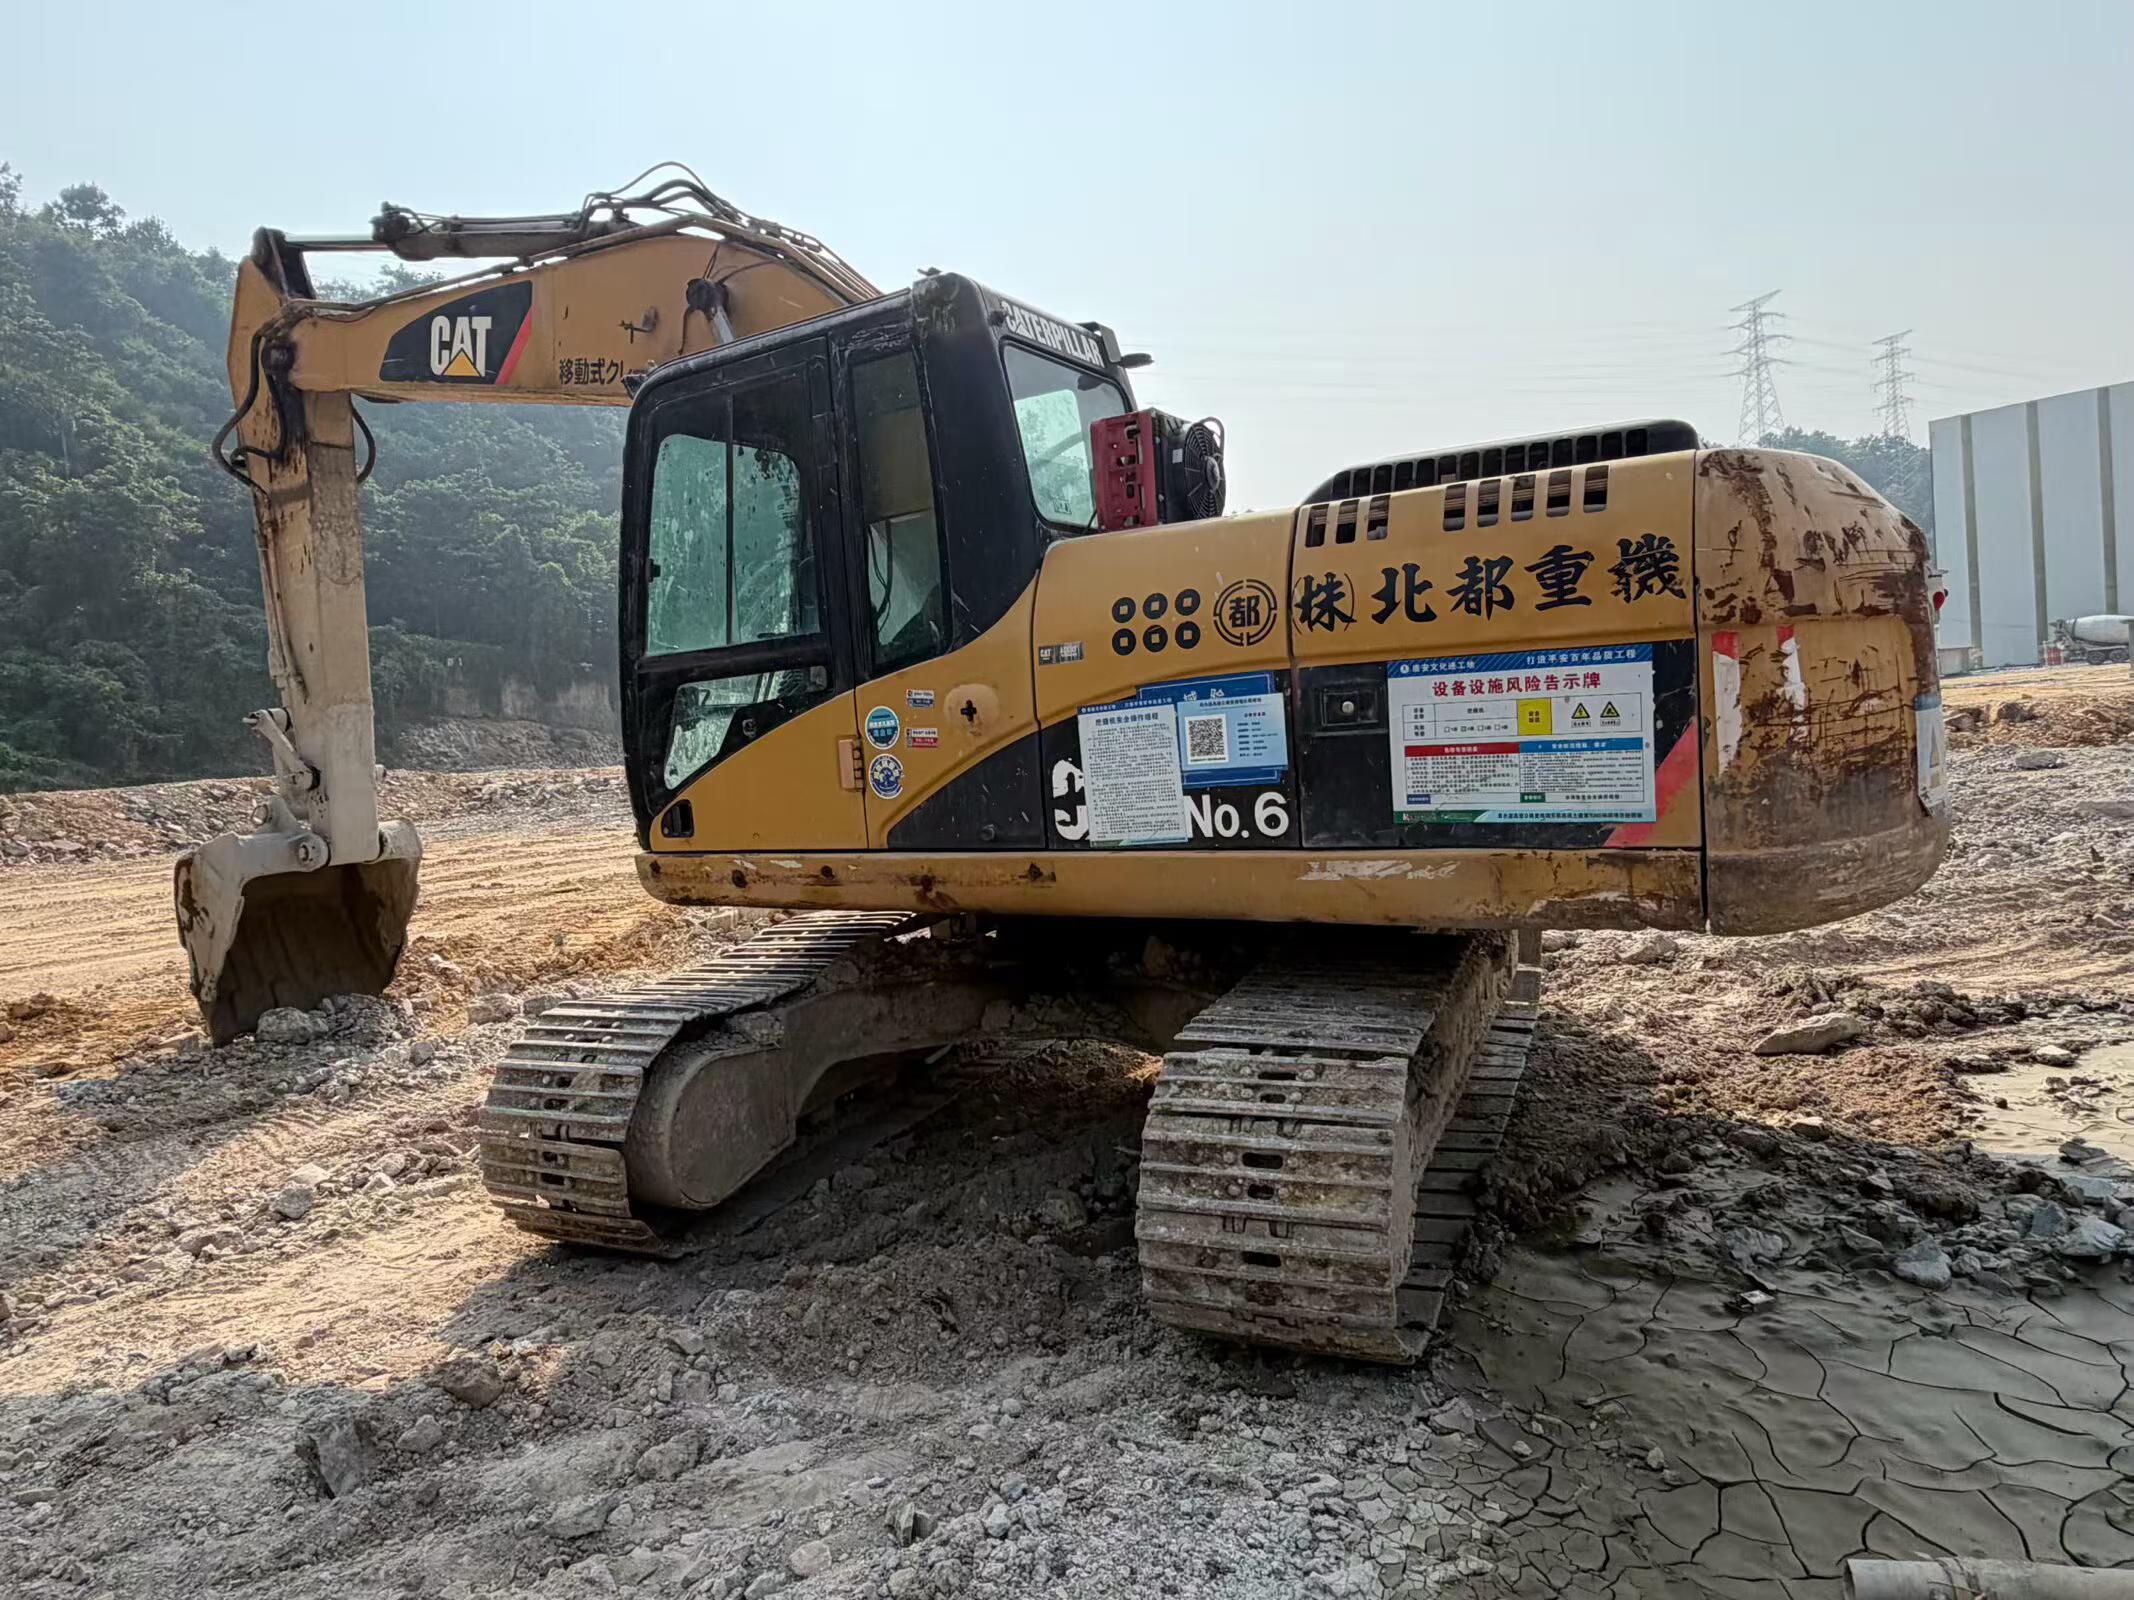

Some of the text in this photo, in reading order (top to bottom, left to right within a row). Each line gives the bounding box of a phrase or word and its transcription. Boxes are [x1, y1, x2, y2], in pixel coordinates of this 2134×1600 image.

[430, 315, 492, 377] CAT
[1001, 300, 1105, 368] CATERPILLAR
[1229, 595, 1260, 628] 都
[1432, 672, 1601, 697] 设备设施风险告示牌
